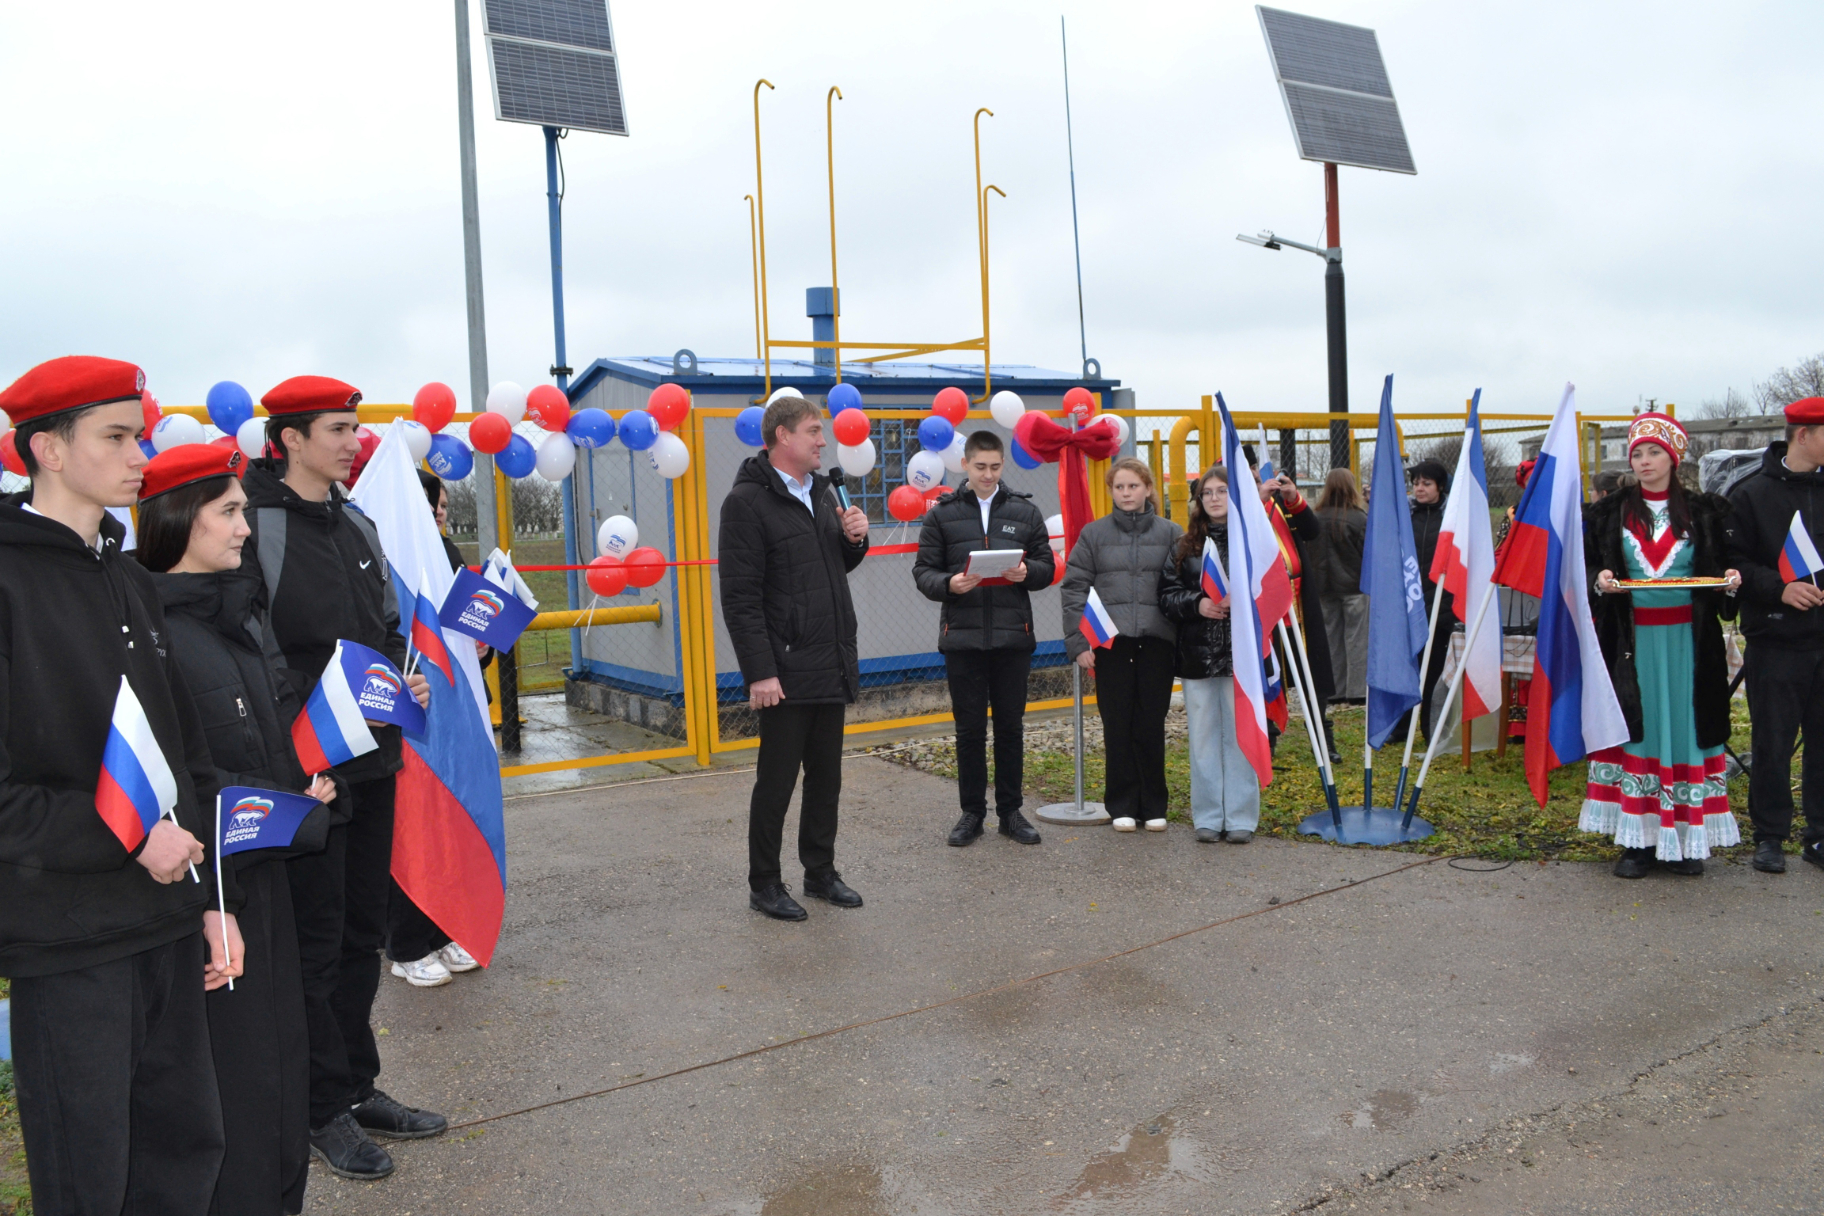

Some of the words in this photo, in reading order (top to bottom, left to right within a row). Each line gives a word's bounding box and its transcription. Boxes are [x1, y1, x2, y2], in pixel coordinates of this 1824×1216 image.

[458, 616, 486, 632] РОССИЯ
[461, 611, 490, 627] ЕДИНАЯ
[360, 692, 395, 705] ЕДИНАЯ
[358, 699, 393, 712] РОССИЯ
[226, 826, 260, 838] ЕДИНАЯ
[224, 833, 258, 846] РОССИЯ
